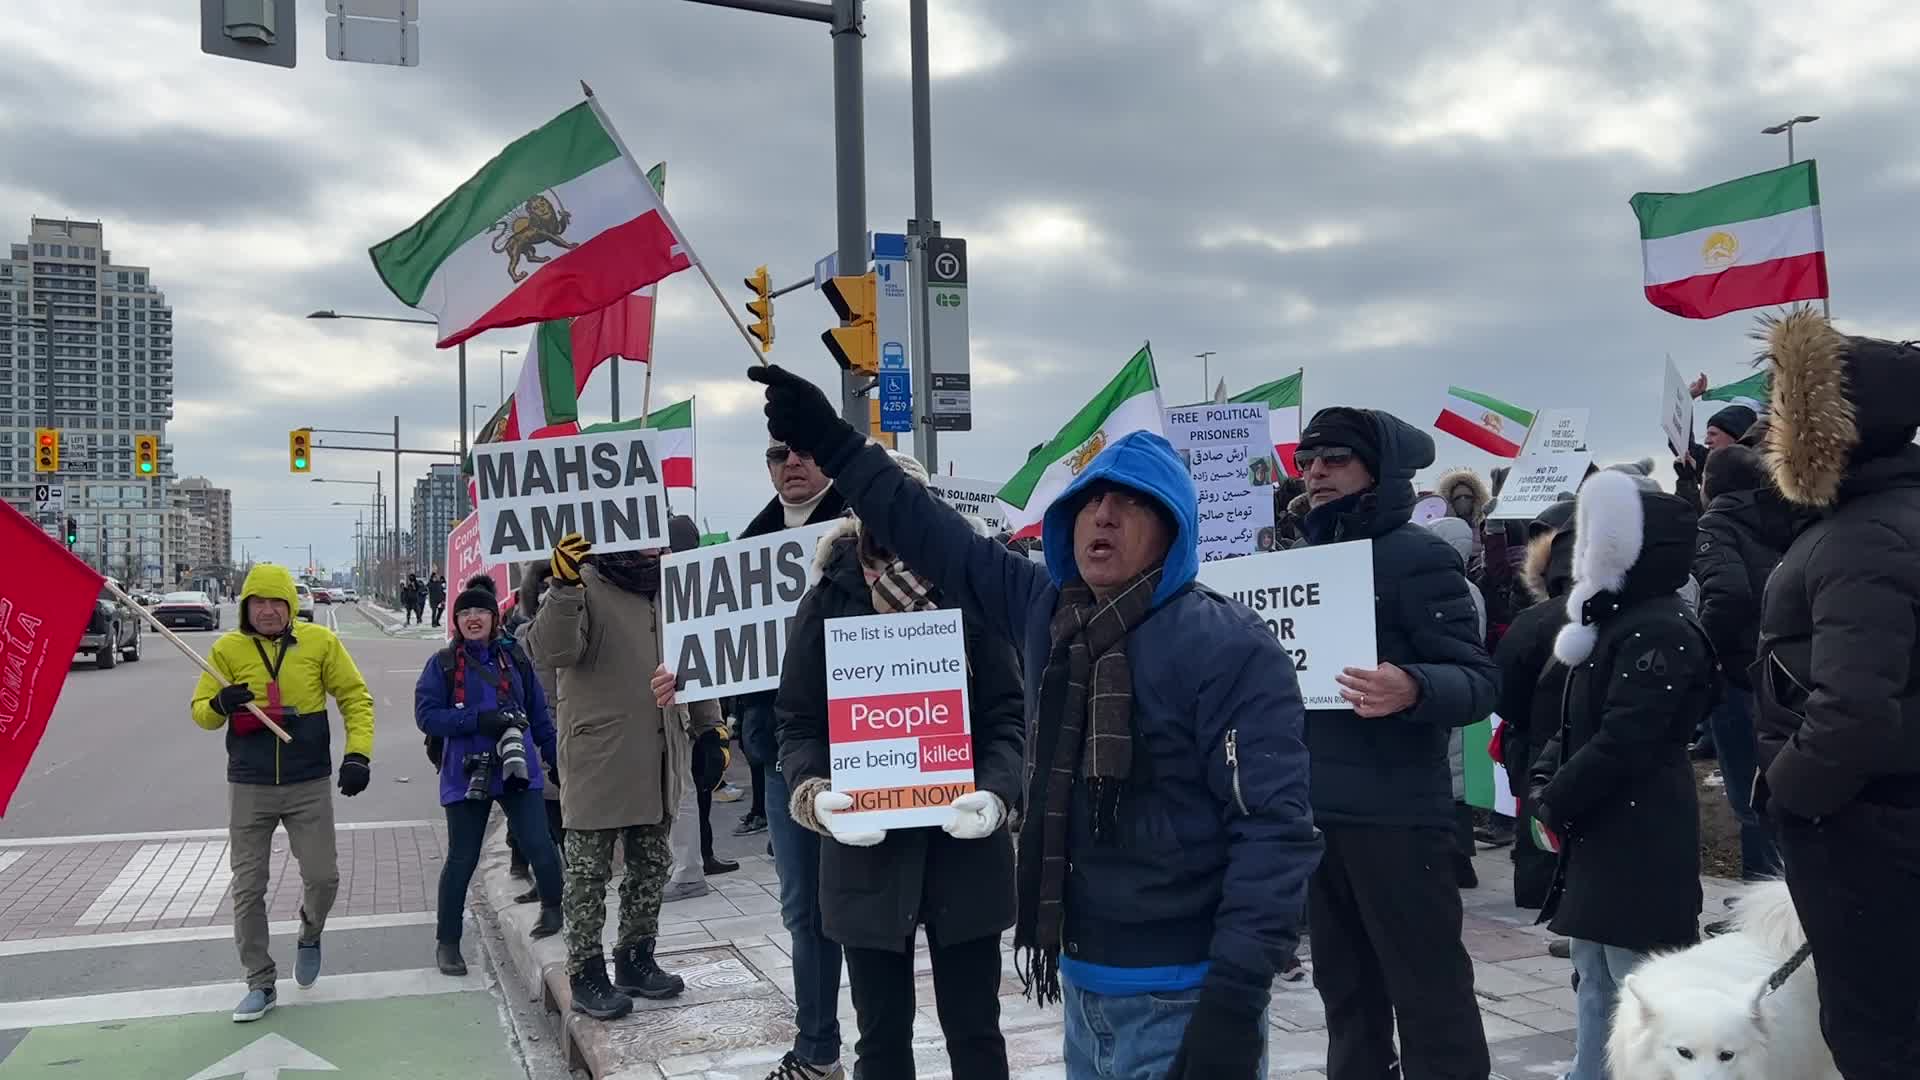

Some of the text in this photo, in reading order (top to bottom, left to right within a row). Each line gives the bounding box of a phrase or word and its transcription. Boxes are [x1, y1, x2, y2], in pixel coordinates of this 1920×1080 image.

[935, 293, 961, 307] GO
[882, 401, 908, 412] 4259
[1170, 407, 1263, 425] FREE POLITICAL
[1189, 427, 1250, 441] PRISONERS
[1192, 446, 1248, 465] آرش صادقی
[477, 439, 659, 500] MAHSA
[1210, 470, 1234, 482] حسین
[1548, 466, 1558, 474] TO
[947, 489, 996, 503] SOLIDARIT
[1197, 488, 1252, 504] حسین رونق
[1529, 493, 1557, 502] REPUBL
[955, 502, 980, 514] WITH
[1198, 506, 1253, 524] توماج صالح
[489, 495, 661, 555] AMINI
[454, 519, 481, 551] Cond
[1229, 528, 1253, 544] نرگس
[459, 539, 482, 573] IRA
[664, 541, 807, 625] MAHS
[830, 619, 957, 643] The list is updated
[1265, 617, 1296, 640] OR
[675, 616, 796, 692] AMI
[832, 657, 961, 683] every minute
[1309, 695, 1333, 705] HUMAN
[850, 696, 950, 733] People
[832, 742, 970, 771] are being killed
[911, 784, 966, 806] NOW
